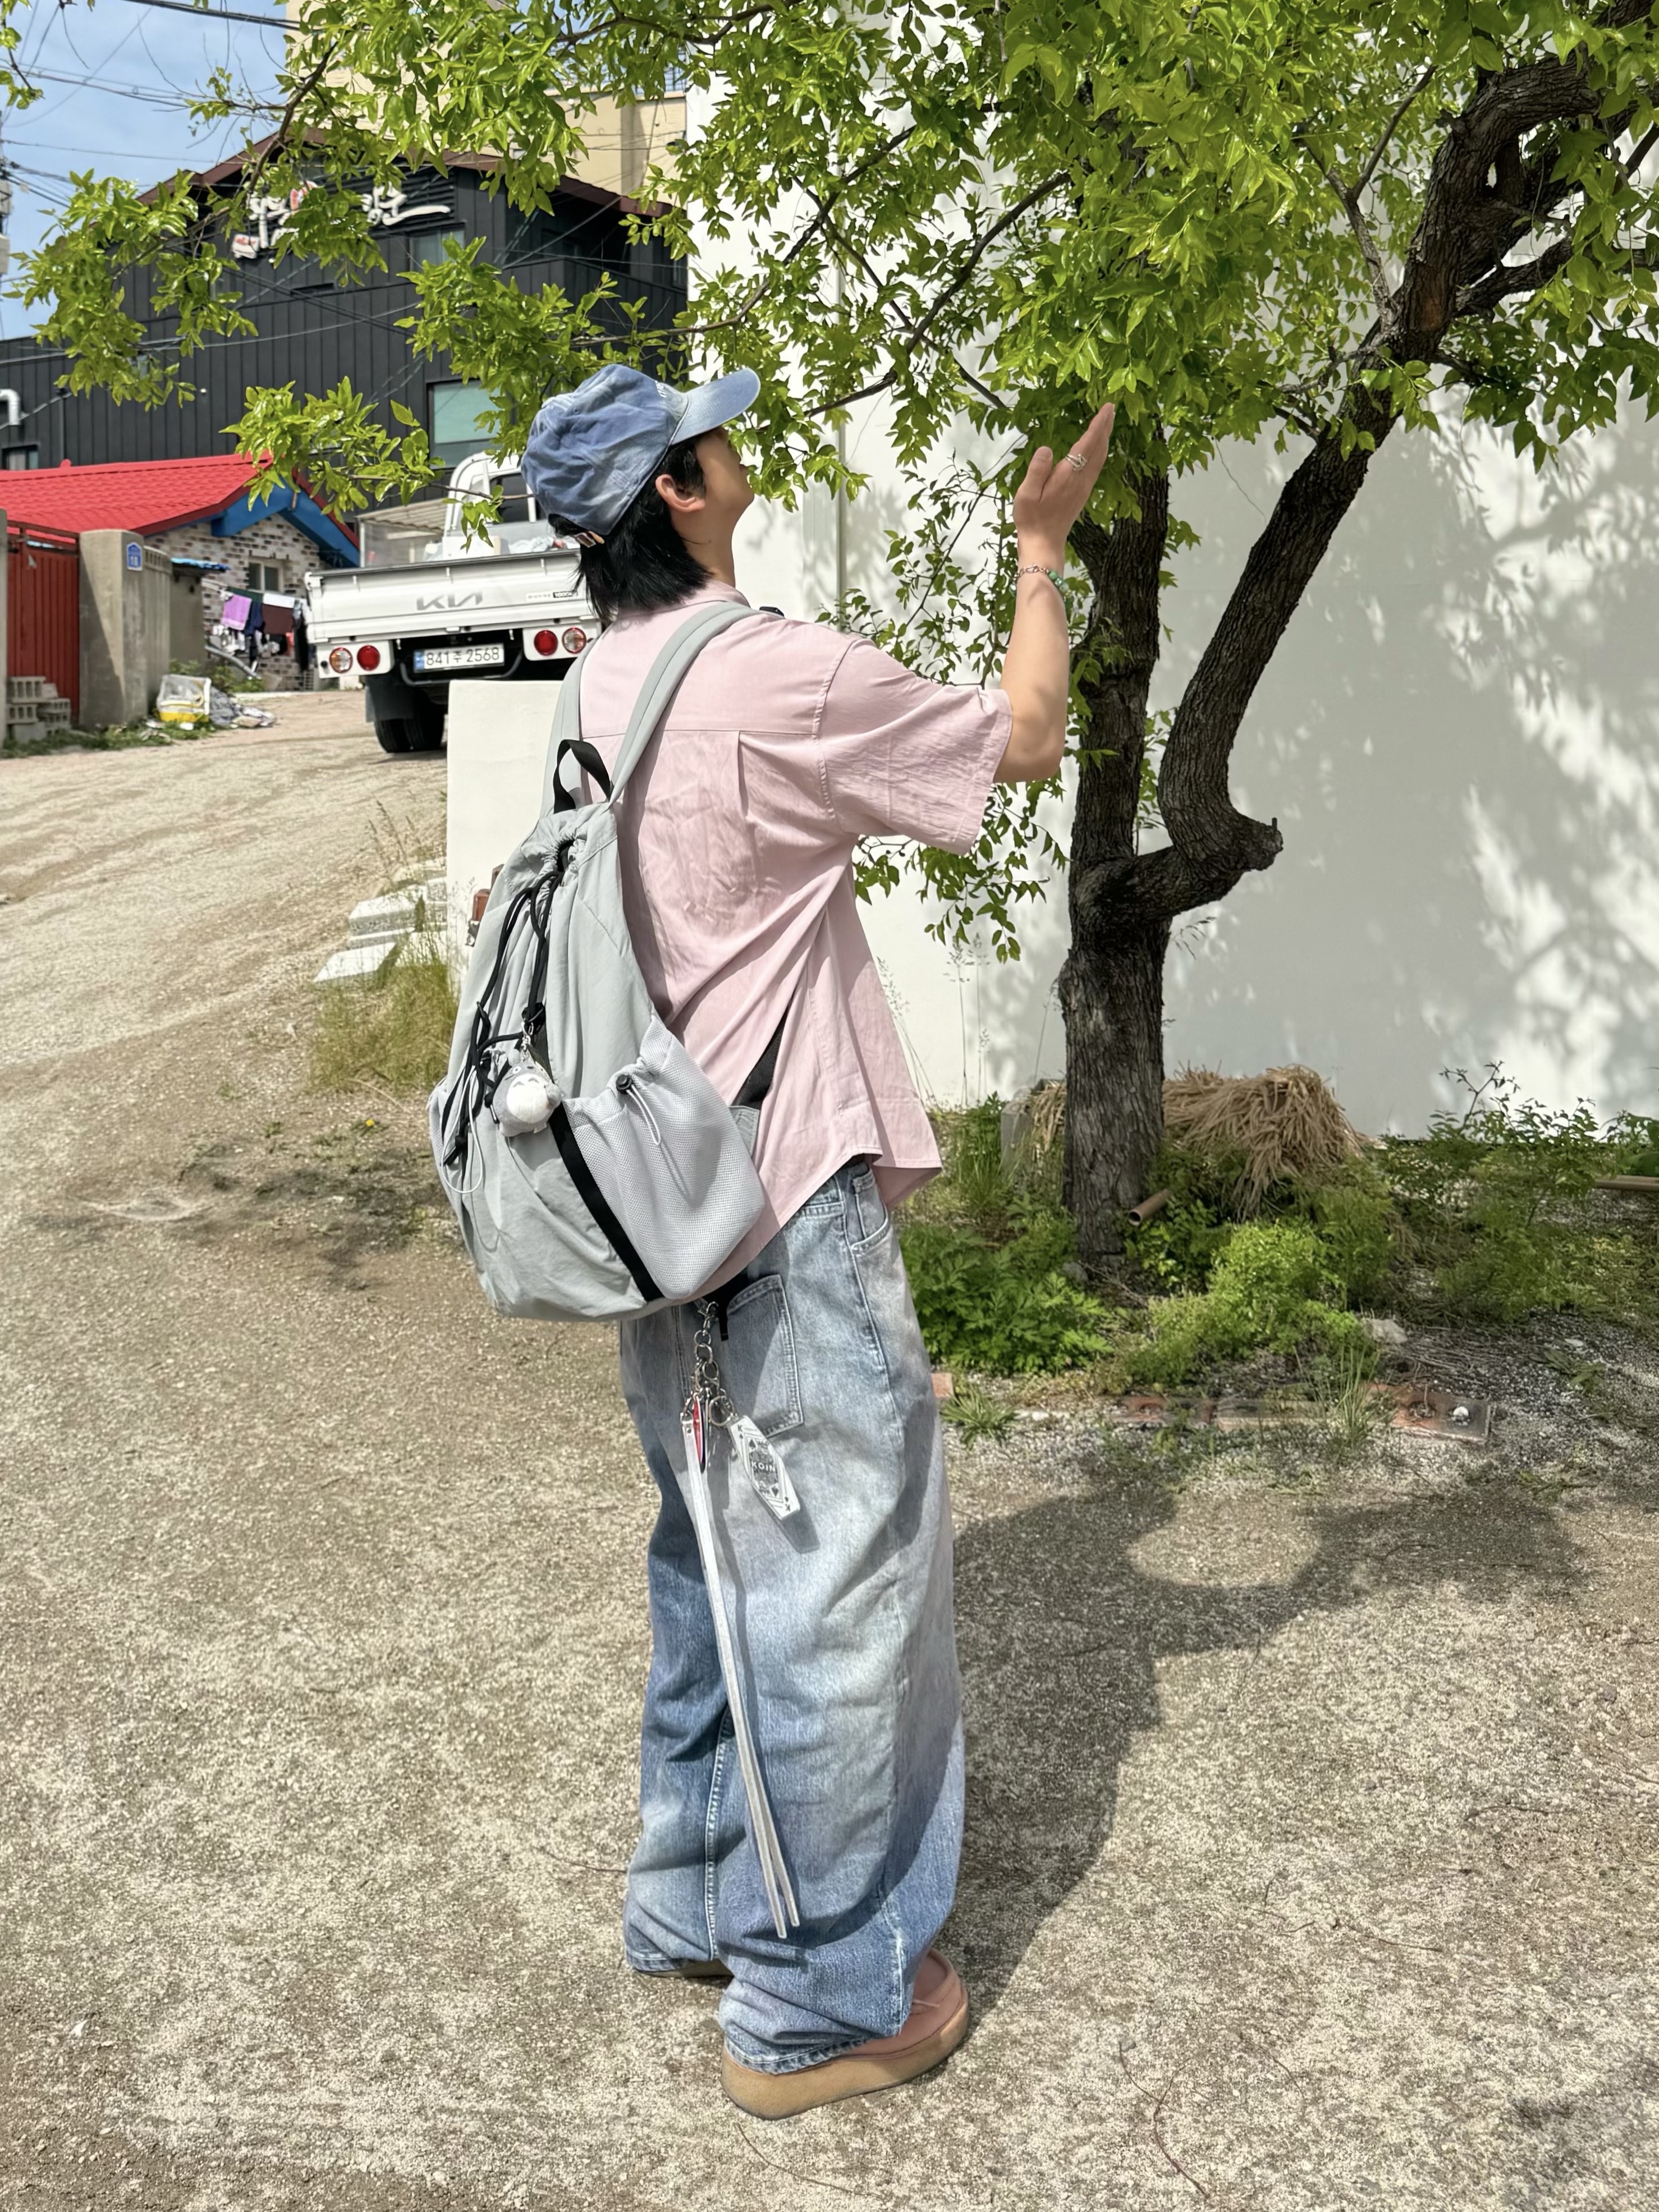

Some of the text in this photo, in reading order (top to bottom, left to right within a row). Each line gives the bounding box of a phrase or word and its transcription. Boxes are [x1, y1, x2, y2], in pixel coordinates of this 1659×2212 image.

[416, 592, 483, 611] KIA
[427, 647, 499, 666] 841주 2568
[751, 1461, 776, 1472] KOIN
